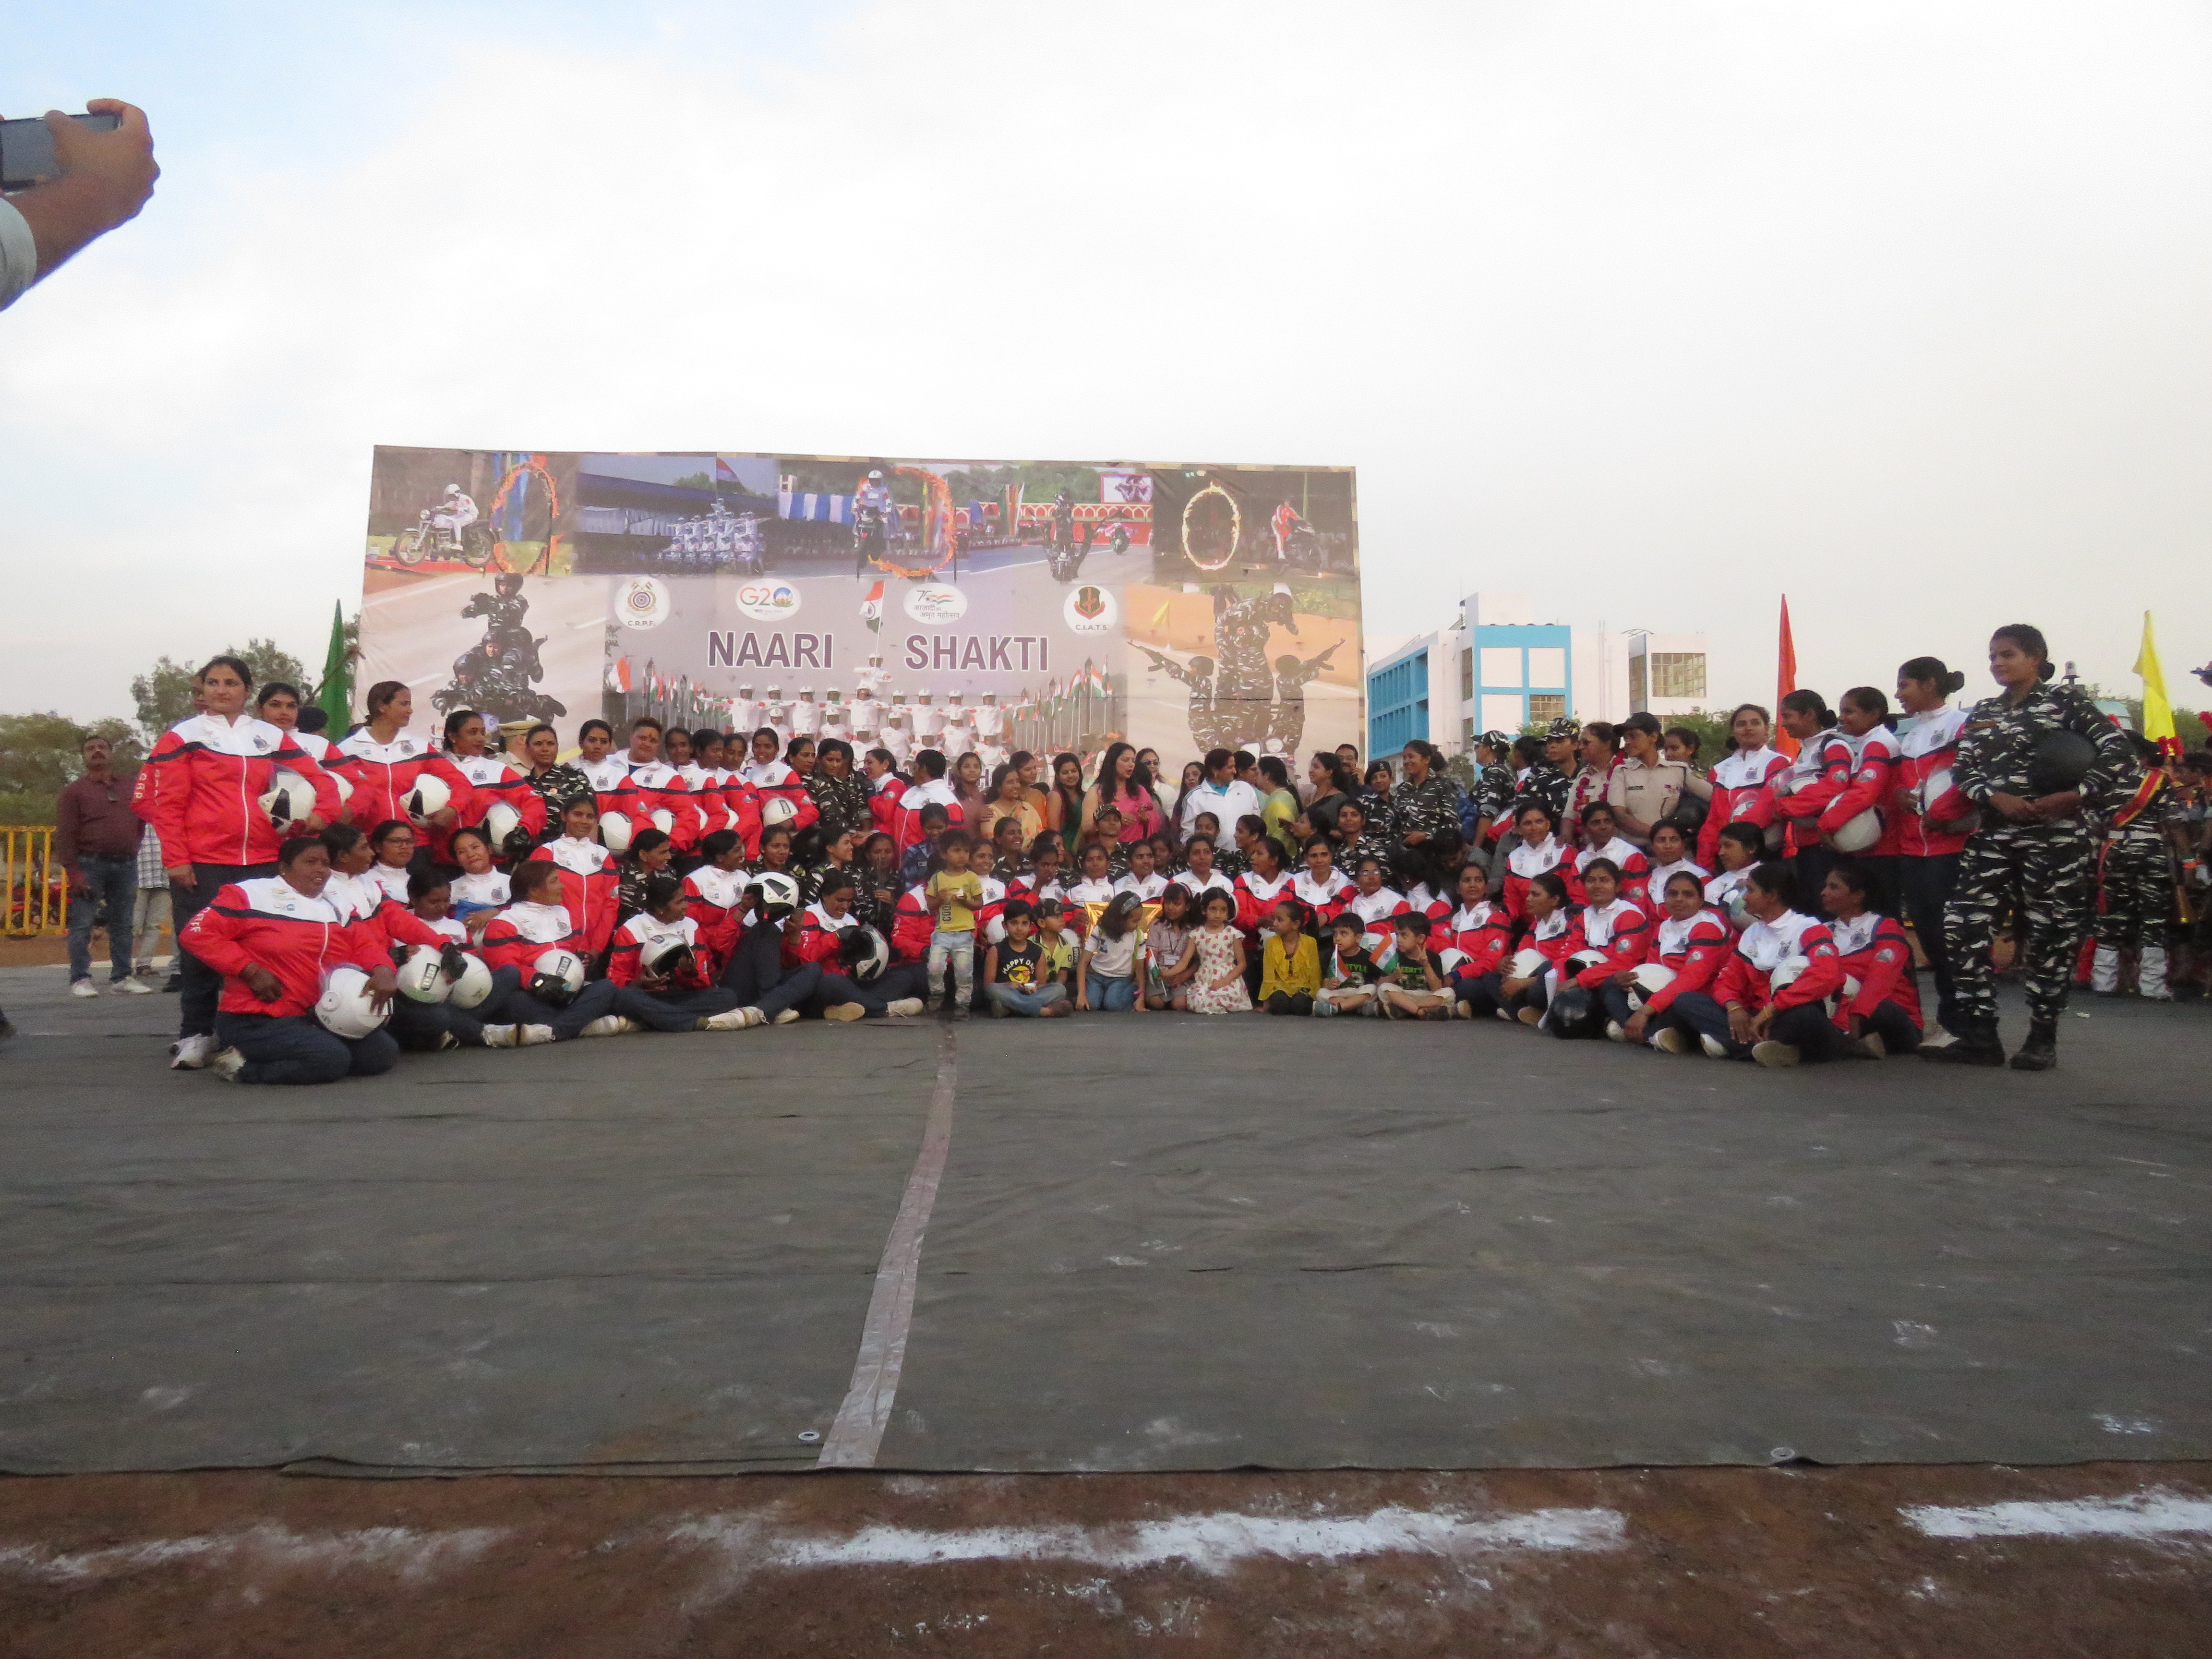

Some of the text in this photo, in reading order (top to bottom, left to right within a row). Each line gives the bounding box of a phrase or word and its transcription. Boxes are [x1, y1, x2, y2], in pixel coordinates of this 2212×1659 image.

[740, 587, 794, 608] G20
[708, 631, 1048, 672] NAARI SHAKTI
[1002, 958, 1024, 974] HAPPY
